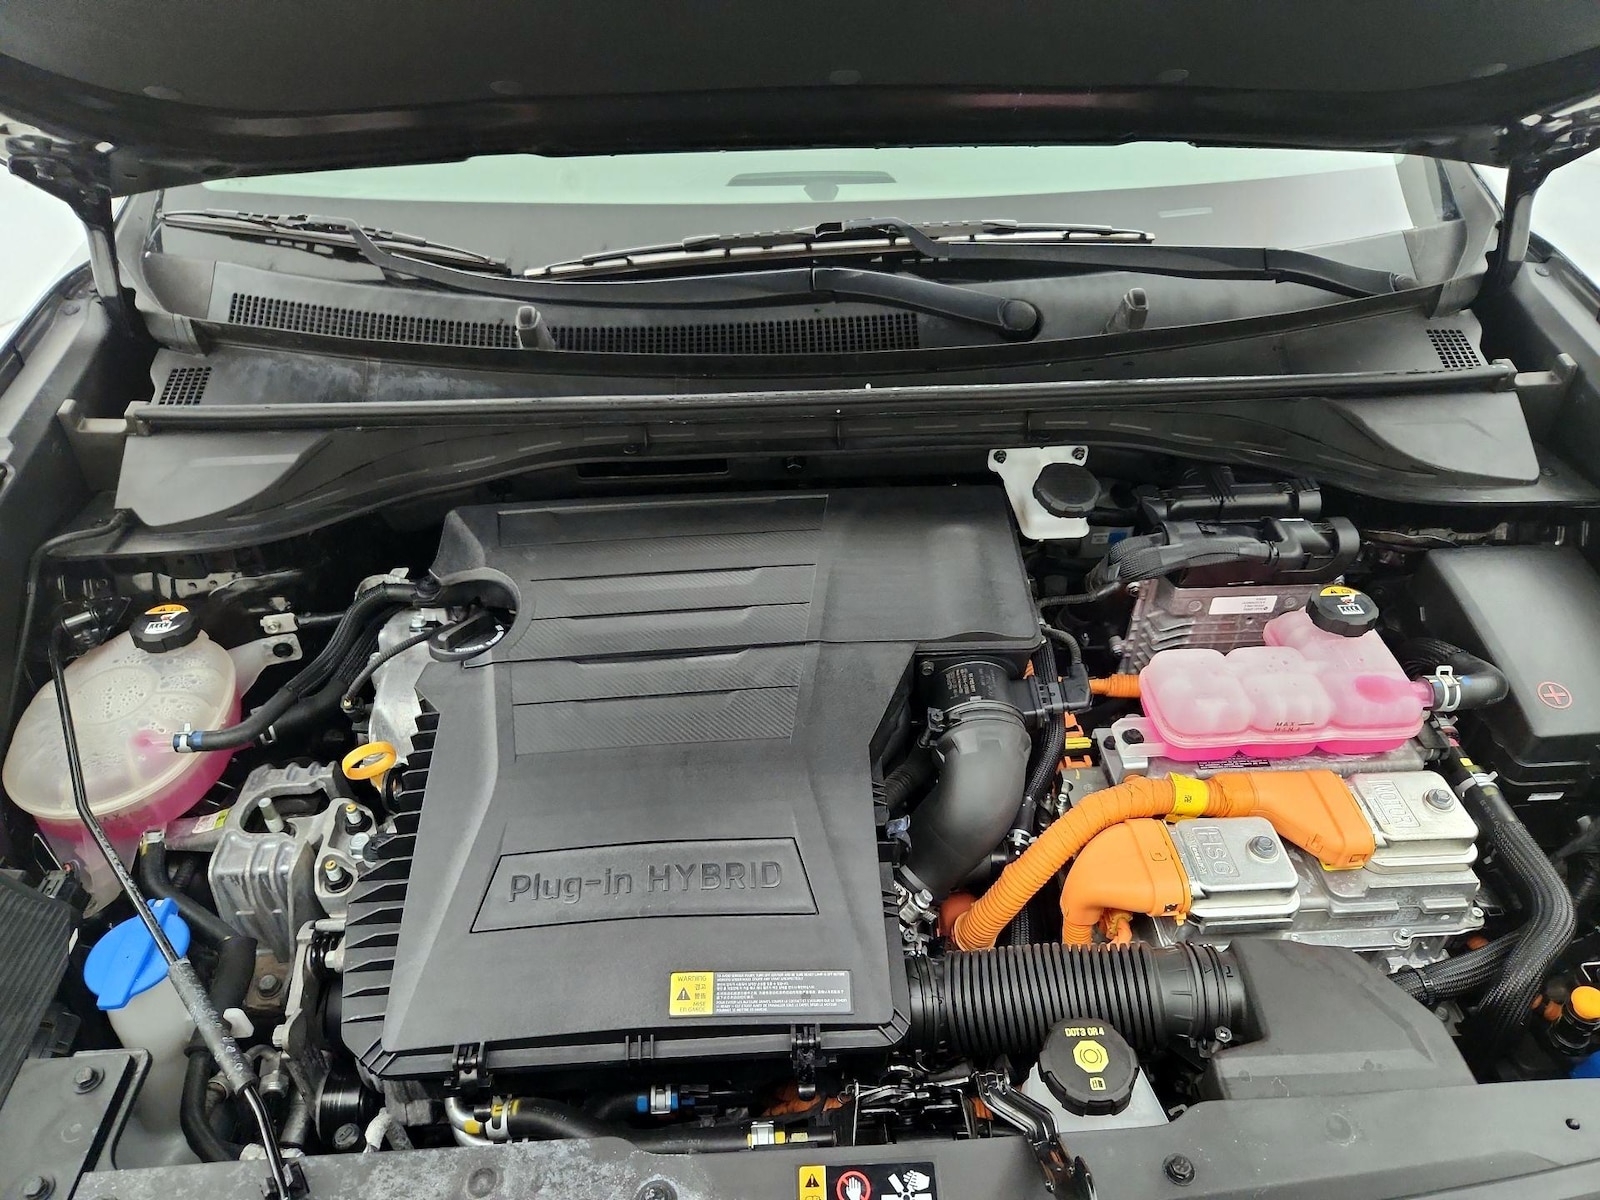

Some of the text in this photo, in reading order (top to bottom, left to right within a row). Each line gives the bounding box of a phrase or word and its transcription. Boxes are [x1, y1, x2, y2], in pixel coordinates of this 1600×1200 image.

[509, 861, 782, 904] Plug-in HYBRID
[1065, 1027, 1105, 1037] DOT3 OR 4
